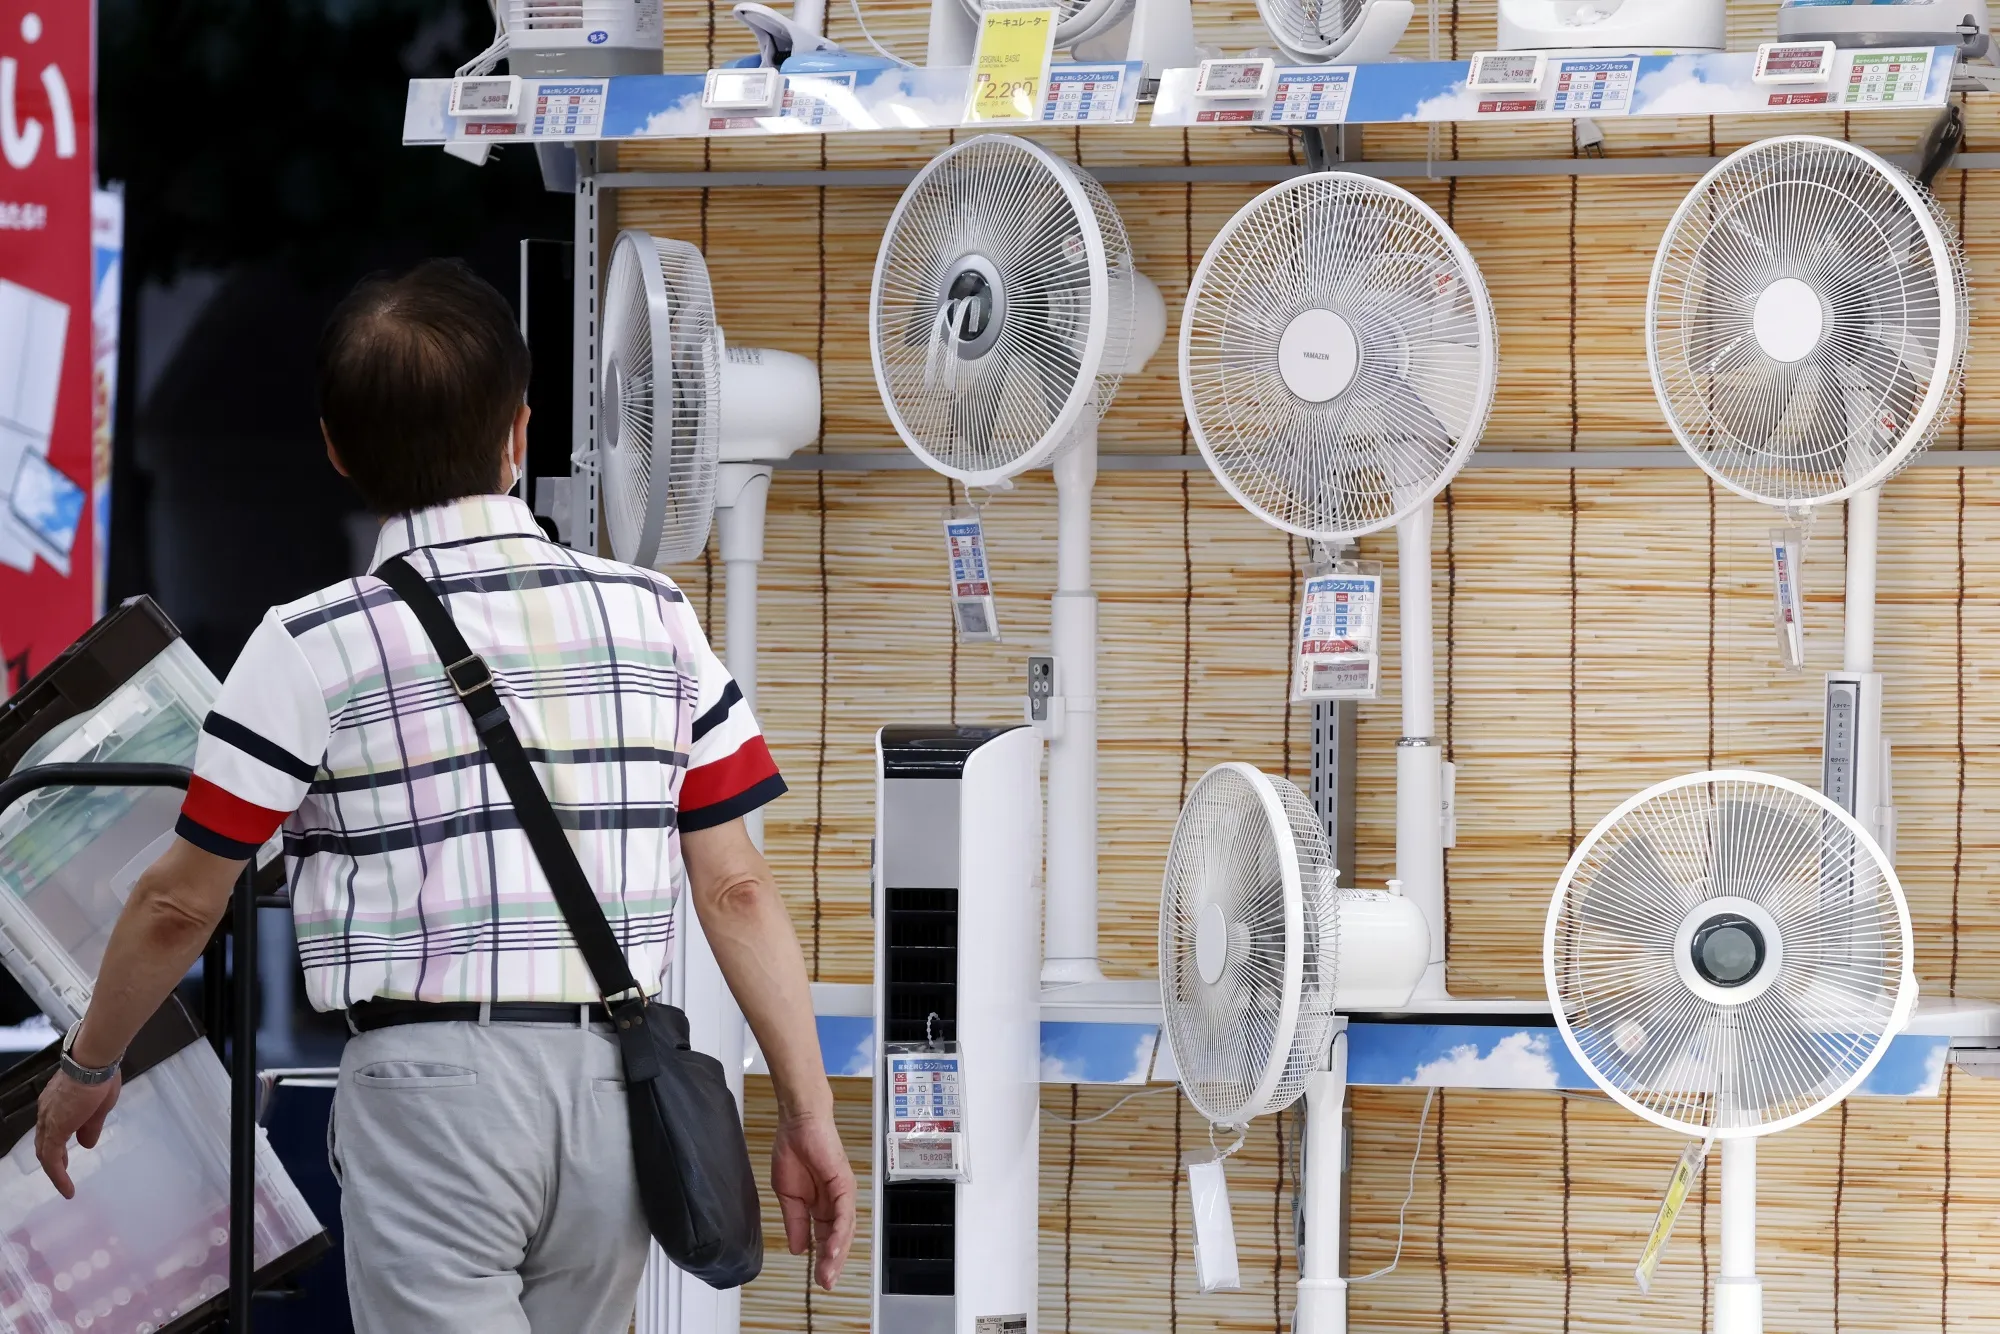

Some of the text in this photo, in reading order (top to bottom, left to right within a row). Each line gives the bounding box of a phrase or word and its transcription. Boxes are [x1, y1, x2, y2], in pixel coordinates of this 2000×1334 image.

[988, 17, 1048, 28] サーキュレーター
[590, 33, 606, 43] 見本
[979, 54, 1020, 64] ORIGINAL BASIC
[1790, 60, 1812, 68] 6,120
[0, 57, 76, 168] い
[1303, 351, 1329, 361] YAMAZEN
[1336, 673, 1358, 682] 9,710
[919, 1153, 943, 1162] 15,820
